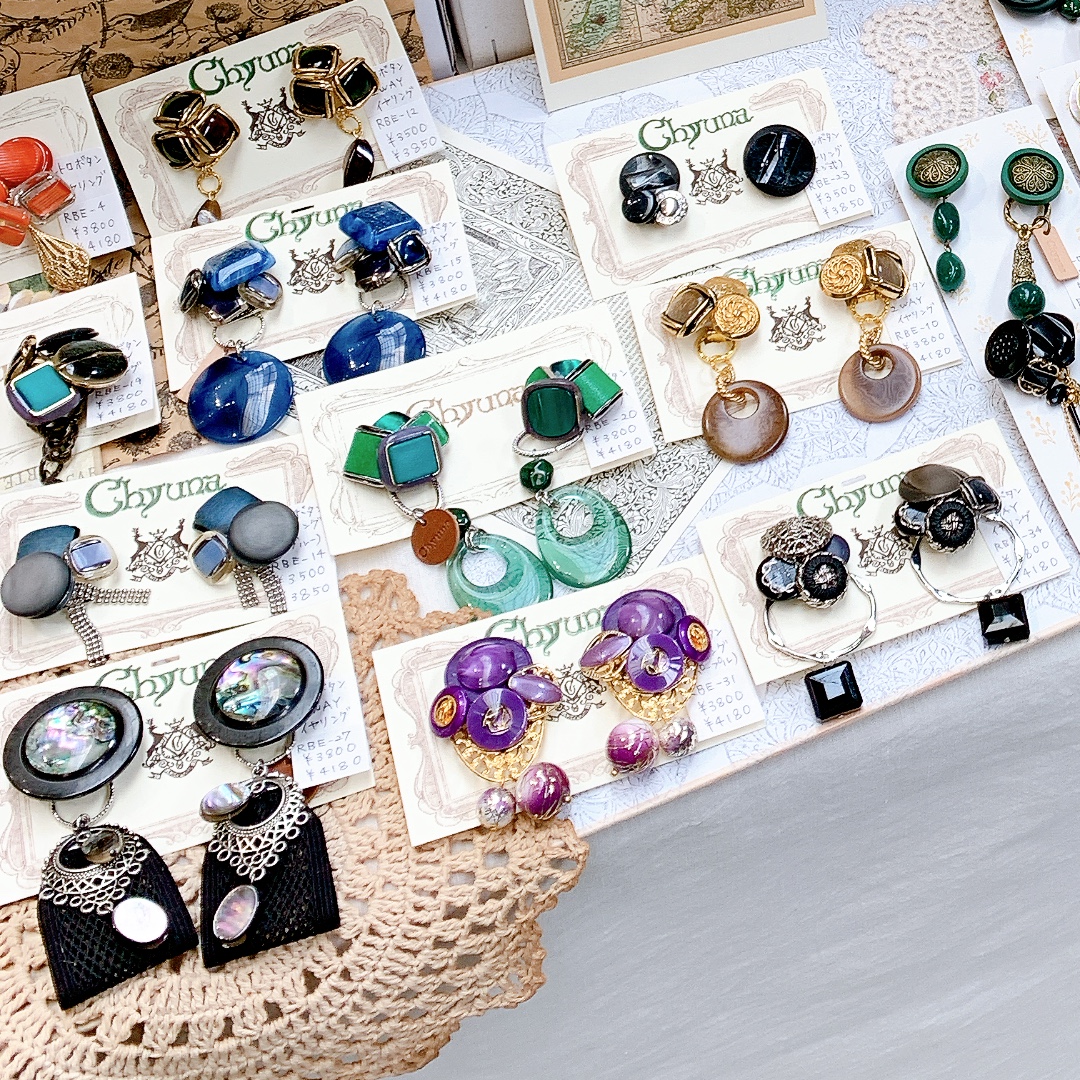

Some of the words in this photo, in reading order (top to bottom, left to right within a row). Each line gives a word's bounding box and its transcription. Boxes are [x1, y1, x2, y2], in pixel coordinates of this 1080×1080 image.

[376, 107, 420, 131] RBE-12
[638, 108, 755, 151] Chyuna
[386, 123, 428, 147] ¥3500
[390, 135, 438, 162] ¥3850
[57, 155, 102, 177] トロボタン
[64, 201, 107, 223] RBE-4
[72, 218, 116, 239] ¥3800
[87, 233, 121, 251] 4180
[722, 261, 827, 301] hyun
[422, 283, 468, 306] ¥4180
[920, 346, 951, 362] 4180
[97, 398, 148, 420] ¥4180
[595, 435, 642, 461] ¥4180
[85, 474, 227, 518] Chyuna
[797, 471, 907, 521] Chyun
[286, 565, 326, 586] 3500
[290, 583, 331, 602] 3850
[485, 604, 610, 657] Chyun
[96, 659, 215, 707] Chyu
[696, 675, 736, 696] BE-31
[306, 754, 362, 781] ¥4180
